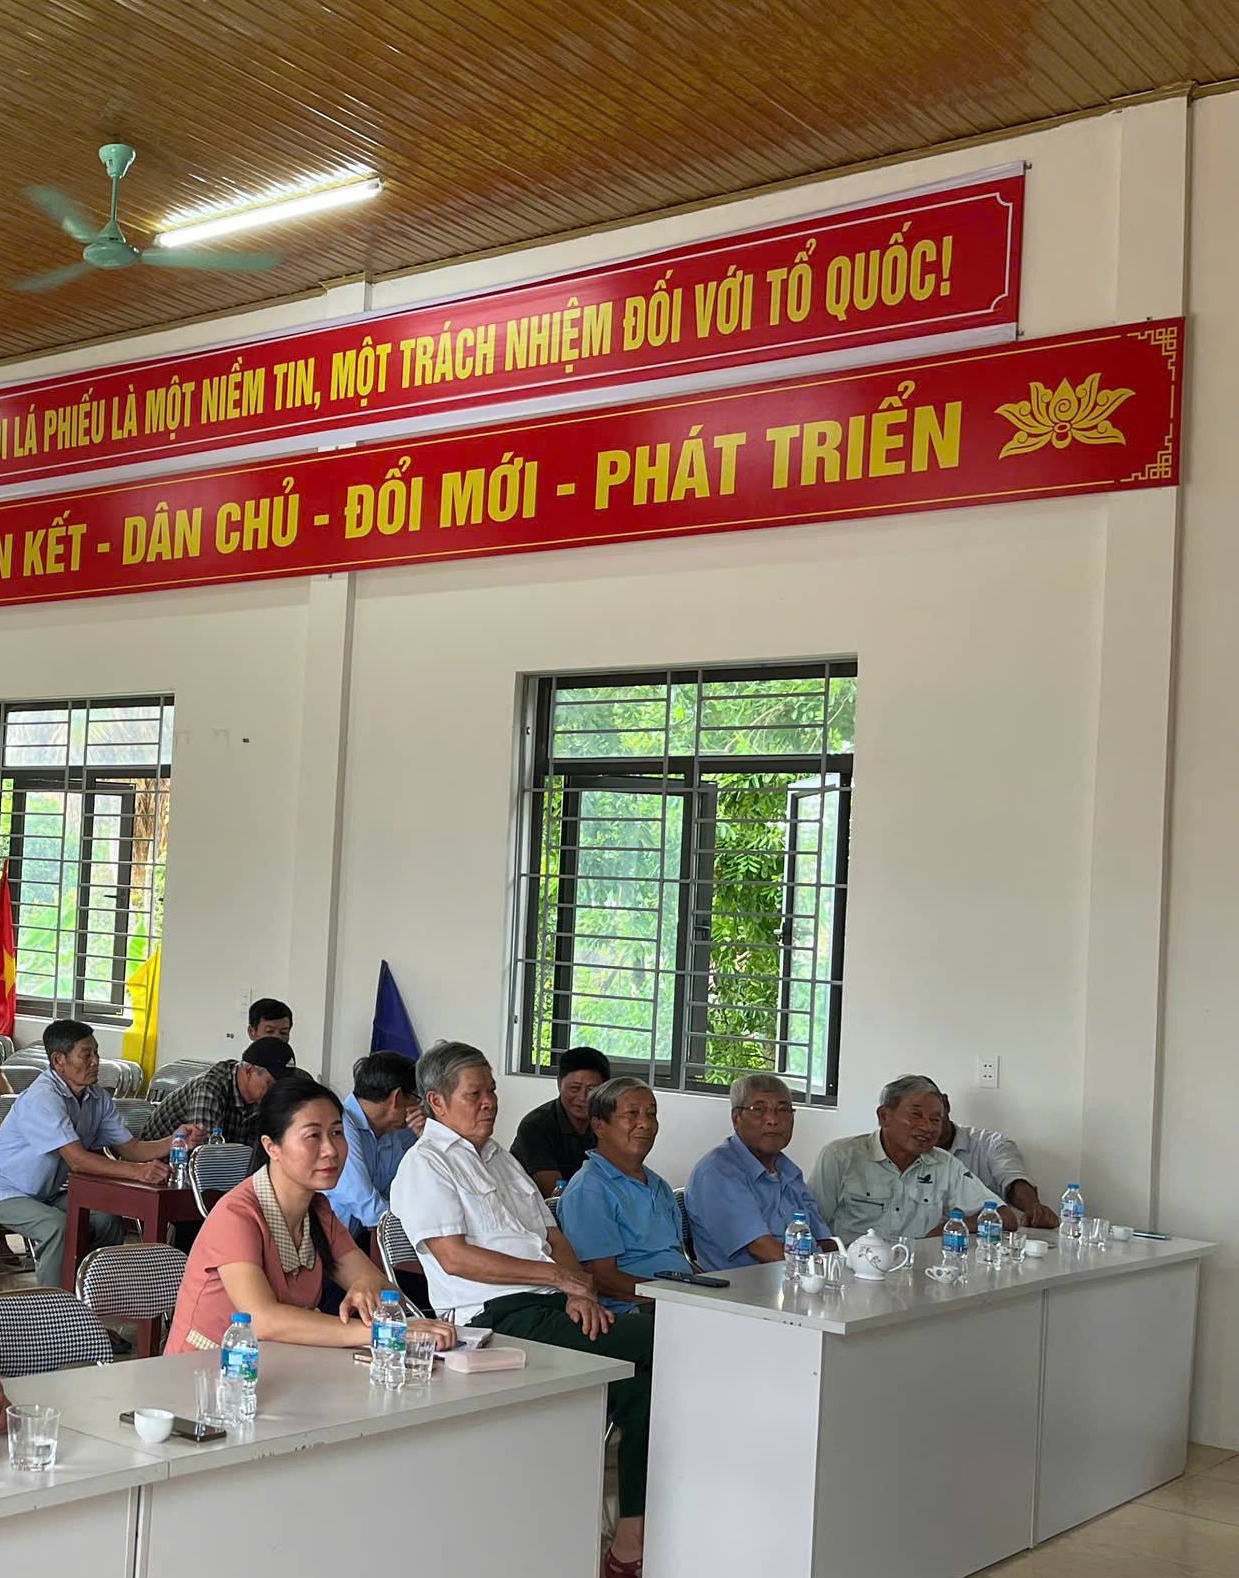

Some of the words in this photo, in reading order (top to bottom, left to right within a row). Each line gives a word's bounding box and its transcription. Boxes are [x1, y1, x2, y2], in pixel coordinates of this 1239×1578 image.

[14, 404, 37, 457] LÁ
[44, 387, 104, 452] PHIẾU
[112, 384, 137, 440] LÀ
[144, 375, 195, 440] MỘT
[202, 356, 265, 423] NIỀM
[274, 358, 321, 411] TIN,
[330, 336, 391, 407] MỘT
[400, 321, 495, 389] TRÁCH
[505, 297, 613, 373] NHIỆM
[623, 270, 683, 351] ĐỐI
[695, 265, 754, 338] VỚI
[767, 238, 817, 326] TỔ
[826, 221, 953, 321] QUỐC!
[23, 510, 87, 576] KẾT
[122, 502, 201, 565] DÂN
[215, 477, 299, 554] CHỦ
[344, 456, 423, 539] ĐỔI
[439, 451, 538, 527] MỚI
[595, 425, 746, 509] PHÁT
[765, 380, 962, 489] TRIỂN
